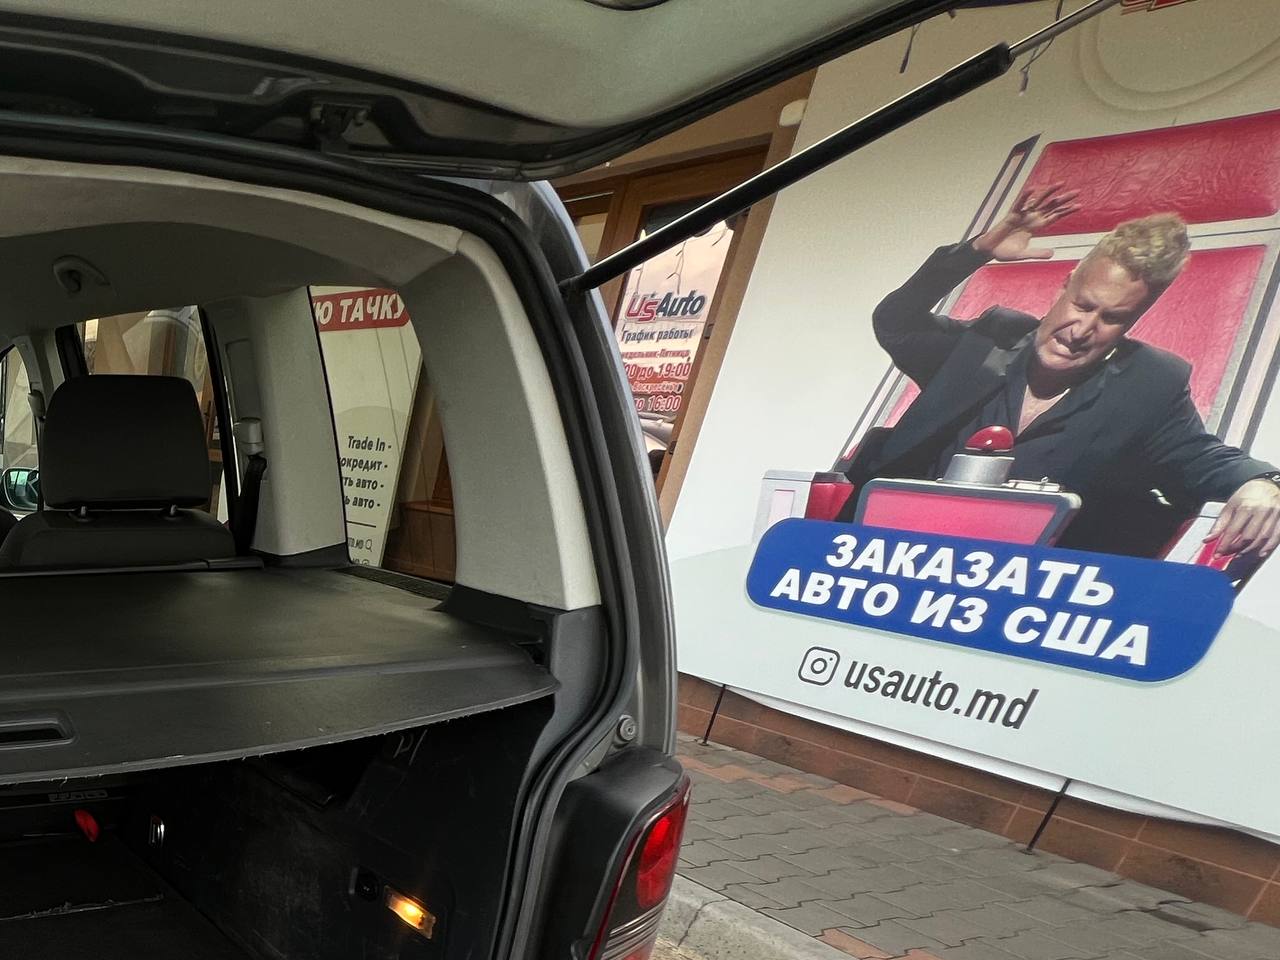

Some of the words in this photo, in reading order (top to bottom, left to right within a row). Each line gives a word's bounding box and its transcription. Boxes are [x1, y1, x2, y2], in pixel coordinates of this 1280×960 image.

[622, 329, 655, 344] График
[656, 327, 694, 343] работы
[659, 362, 691, 377] 19:00
[649, 395, 681, 411] 16:00
[348, 435, 373, 451] Trade
[375, 437, 386, 452] In
[339, 457, 382, 472] окредит
[356, 478, 378, 490] авто
[352, 496, 375, 509] авто
[824, 533, 1116, 607] ЗАКАЗАТЬ
[769, 568, 900, 617] АВТО
[910, 591, 987, 634] ИЗ
[1002, 606, 1151, 667] США
[842, 654, 1040, 731] usauto.md
